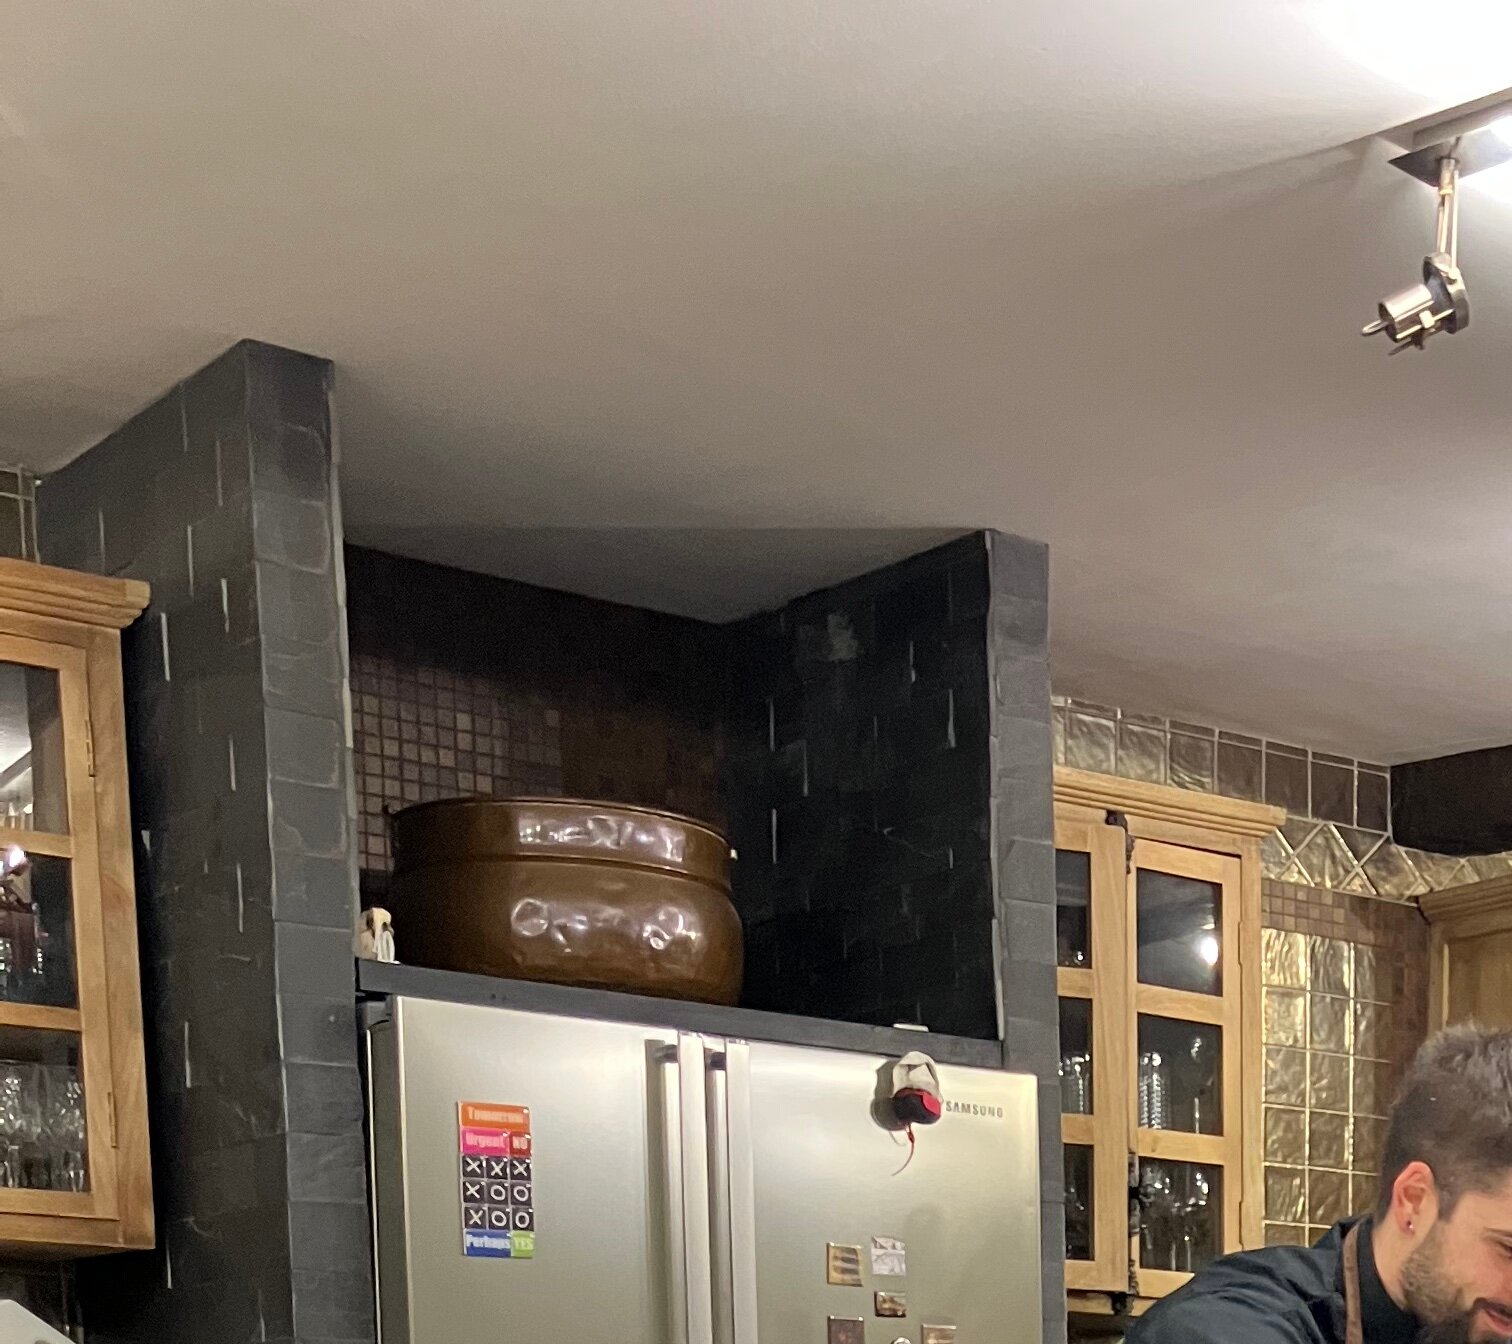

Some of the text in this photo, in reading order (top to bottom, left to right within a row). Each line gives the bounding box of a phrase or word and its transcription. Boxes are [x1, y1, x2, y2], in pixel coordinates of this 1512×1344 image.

[945, 1100, 1004, 1118] SAMSUNG
[512, 1135, 528, 1150] NO
[514, 1237, 533, 1251] YES
